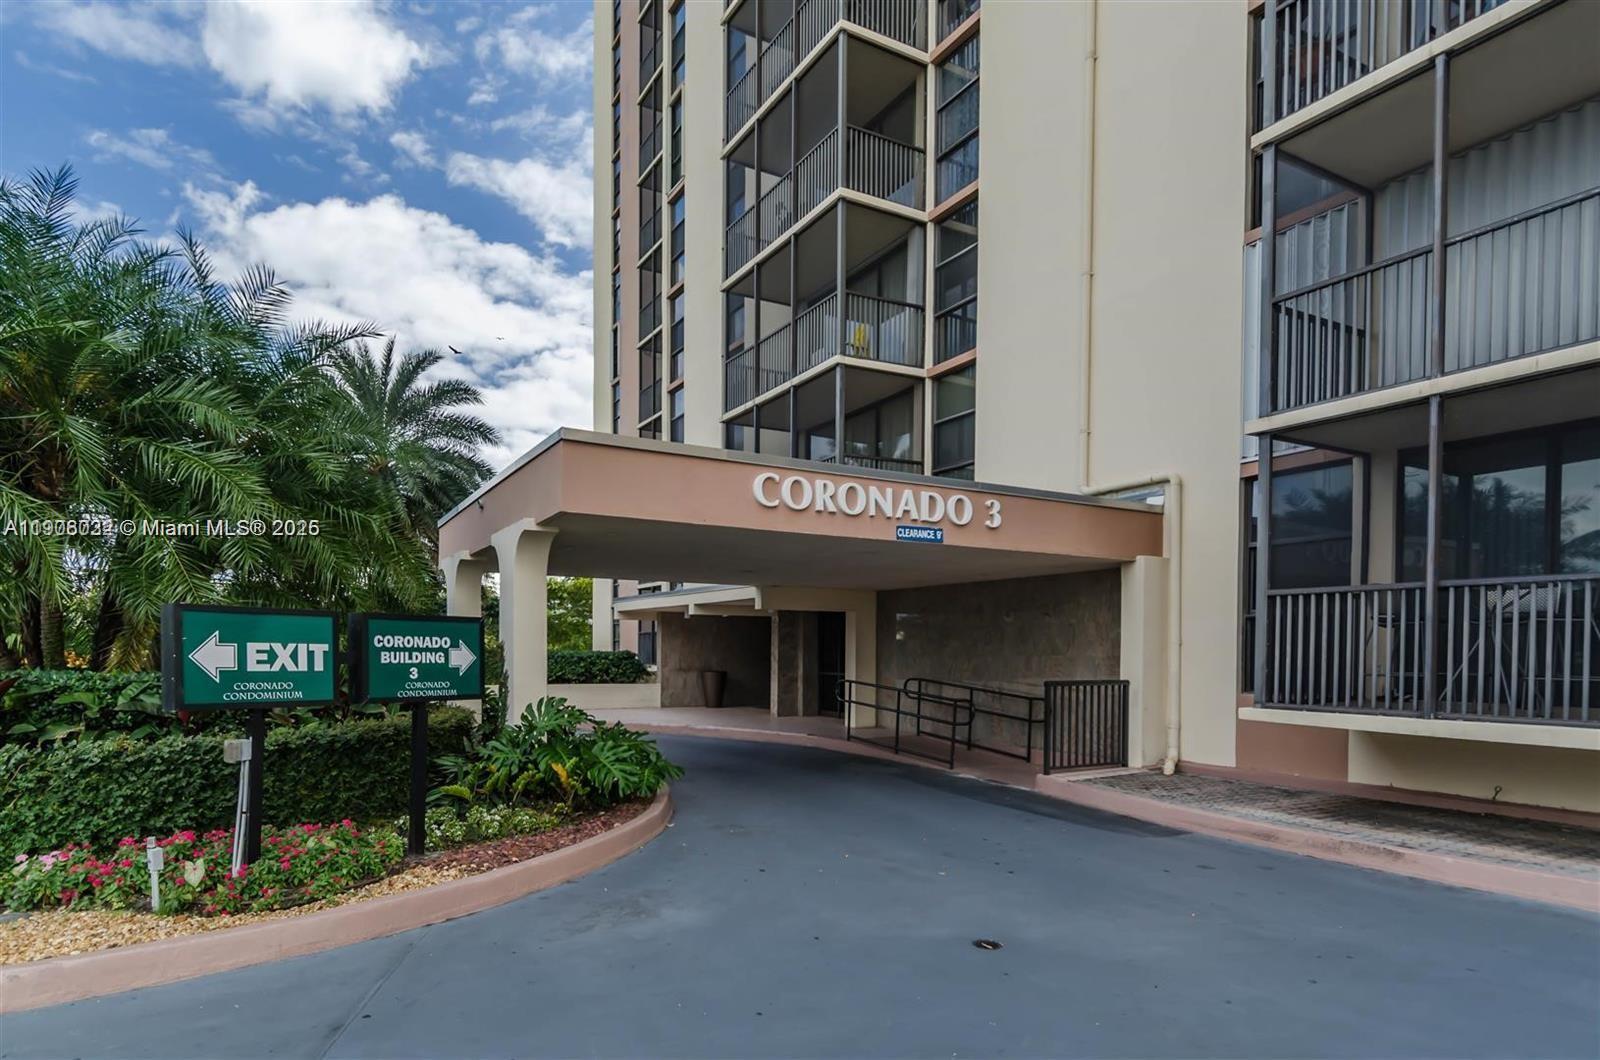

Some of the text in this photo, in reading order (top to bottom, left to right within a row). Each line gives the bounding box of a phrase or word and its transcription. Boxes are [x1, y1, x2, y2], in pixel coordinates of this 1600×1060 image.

[752, 472, 1002, 529] CORONADO 3
[897, 527, 935, 539] CLEARANCE
[373, 635, 451, 649] CORONADO
[246, 642, 329, 672] EXIT
[380, 651, 446, 664] BUILDING
[409, 667, 419, 680] 3
[233, 681, 294, 691] CORONADO
[404, 681, 451, 690] CORONADO
[223, 691, 303, 701] CONDOMINIUM
[397, 689, 458, 698] CONDOMINIUM
